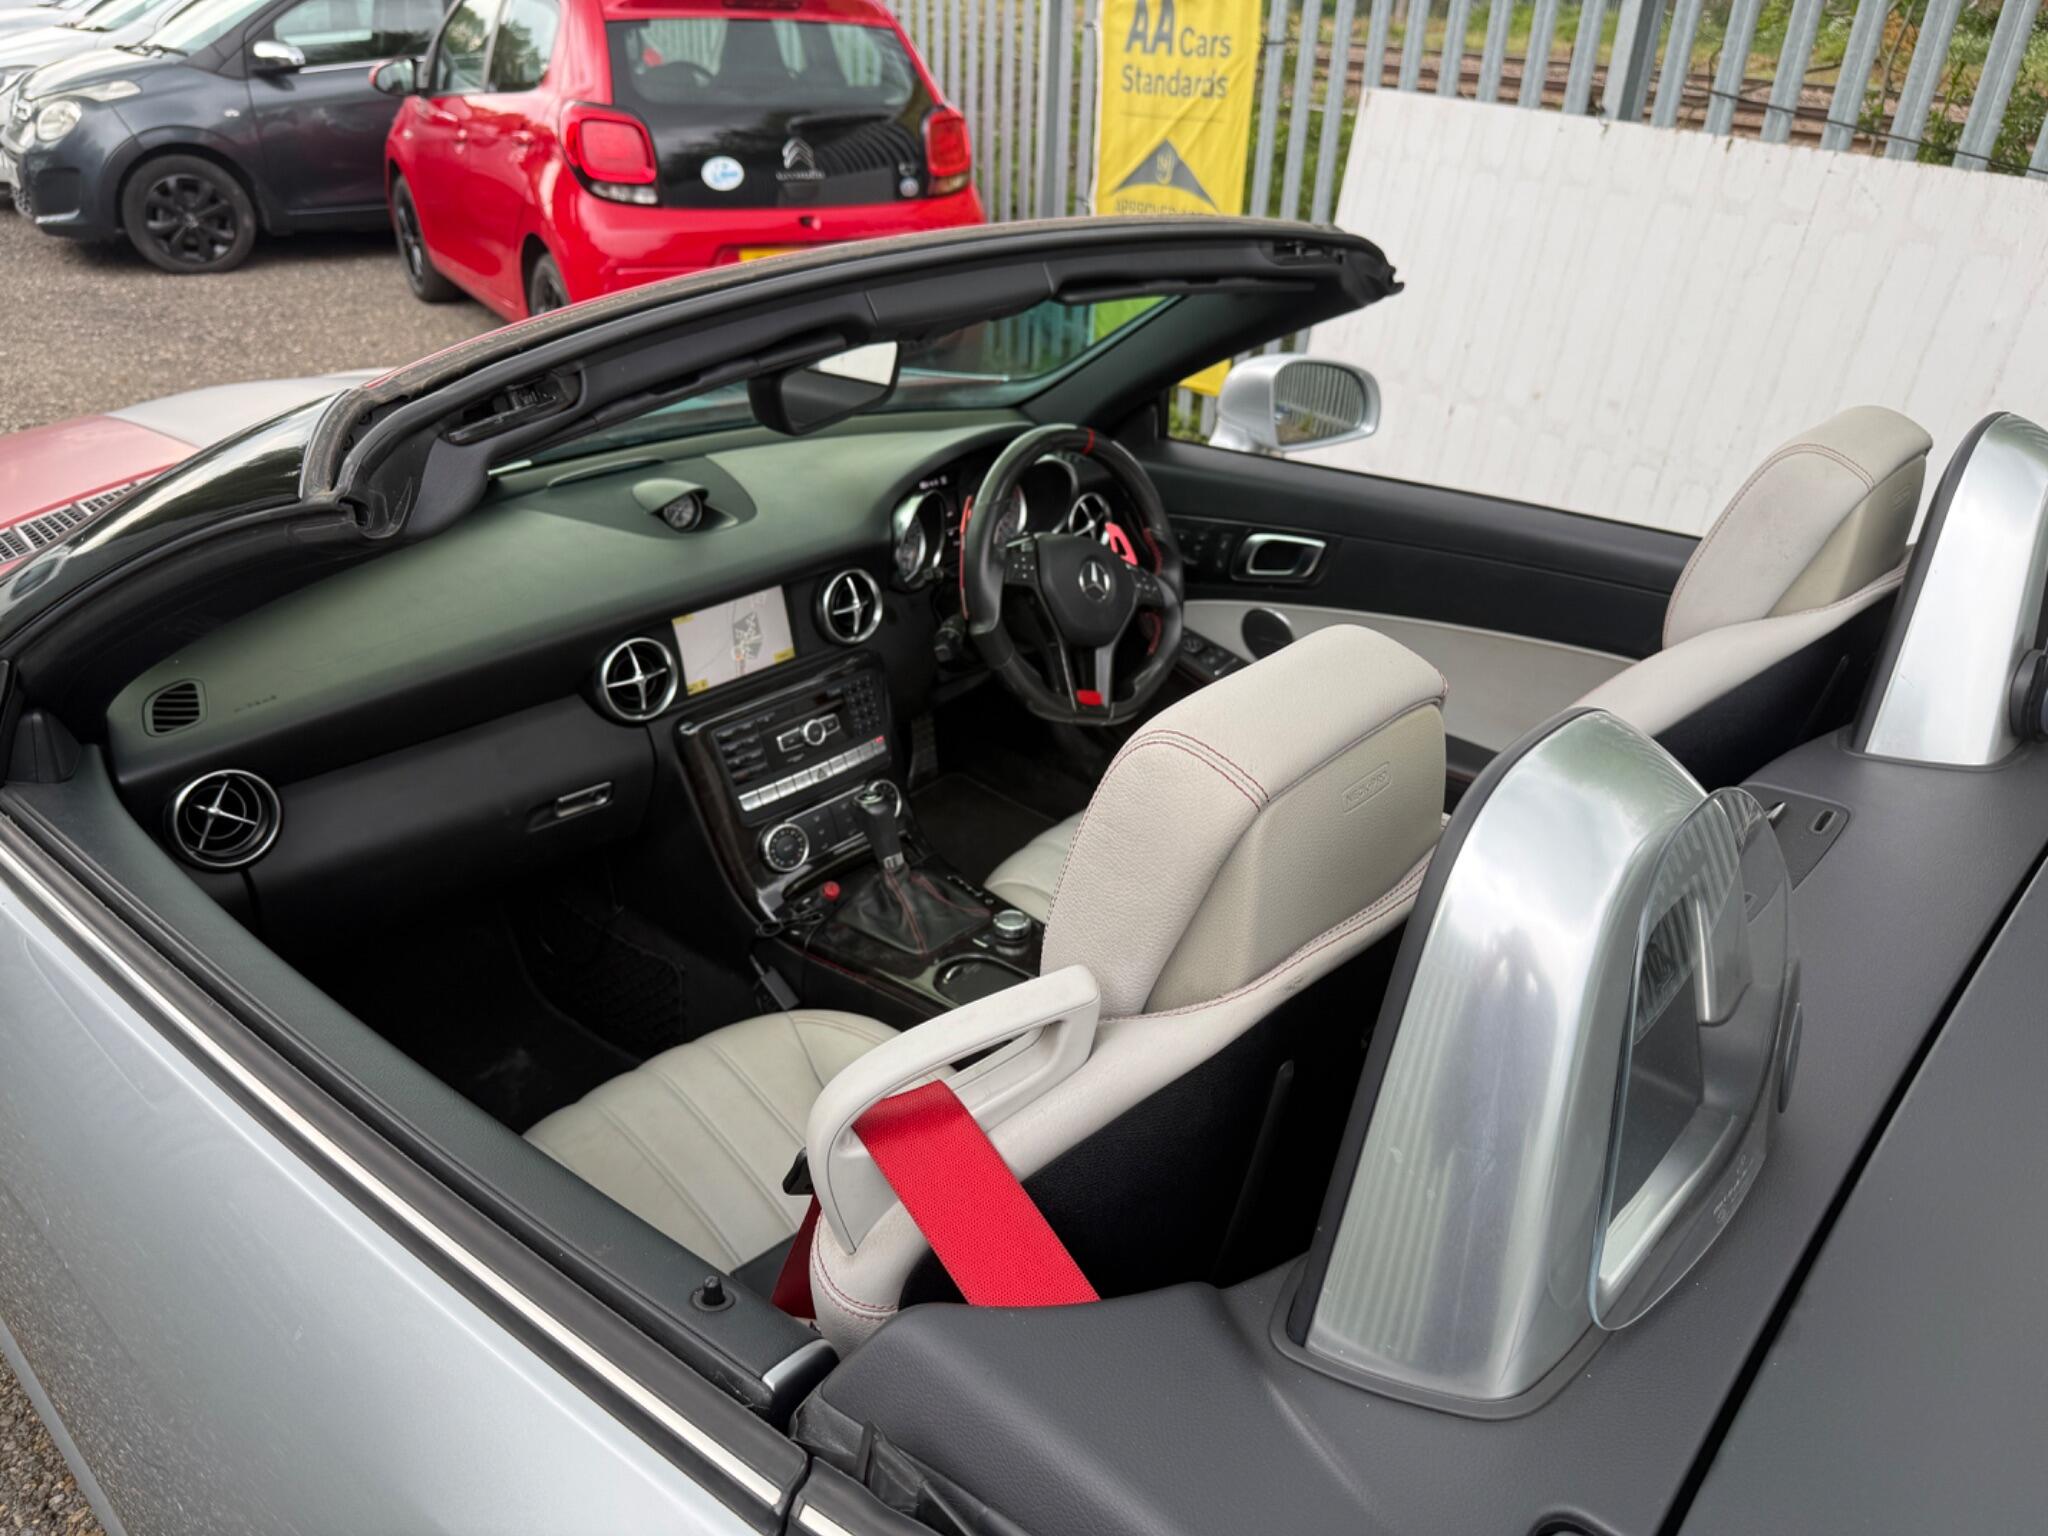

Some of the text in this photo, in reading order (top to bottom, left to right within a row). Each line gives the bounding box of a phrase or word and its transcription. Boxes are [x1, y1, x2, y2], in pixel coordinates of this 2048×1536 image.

[1124, 0, 1231, 58] AA Cars
[1121, 63, 1228, 98] Standards
